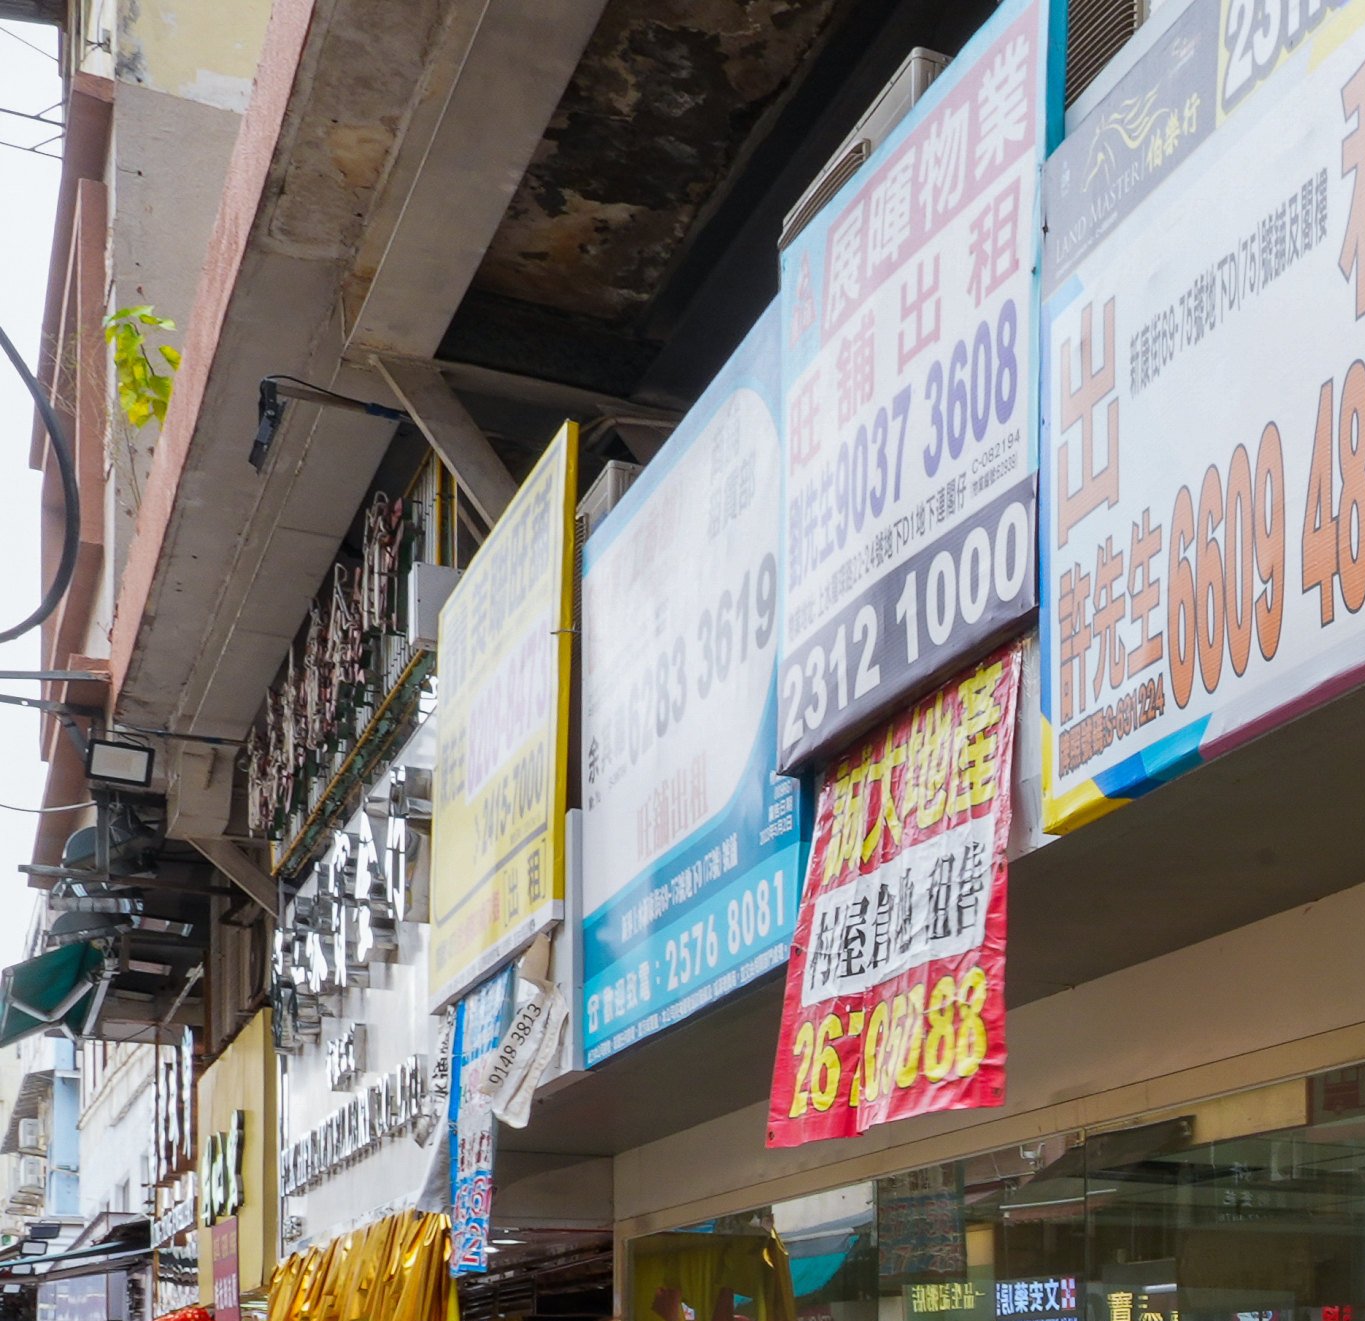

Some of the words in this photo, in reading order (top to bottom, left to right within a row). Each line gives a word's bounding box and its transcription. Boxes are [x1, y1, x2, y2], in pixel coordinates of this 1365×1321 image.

[834, 381, 912, 553] 9037
[923, 289, 1017, 488] 3608
[1058, 295, 1120, 549] 出
[696, 544, 778, 703] 3619
[782, 605, 881, 747] 2312
[896, 501, 1028, 666] 1000
[1059, 506, 1165, 727] 許先生
[1167, 420, 1286, 710] 6609
[664, 914, 718, 992] 2576
[727, 869, 785, 955] 8081
